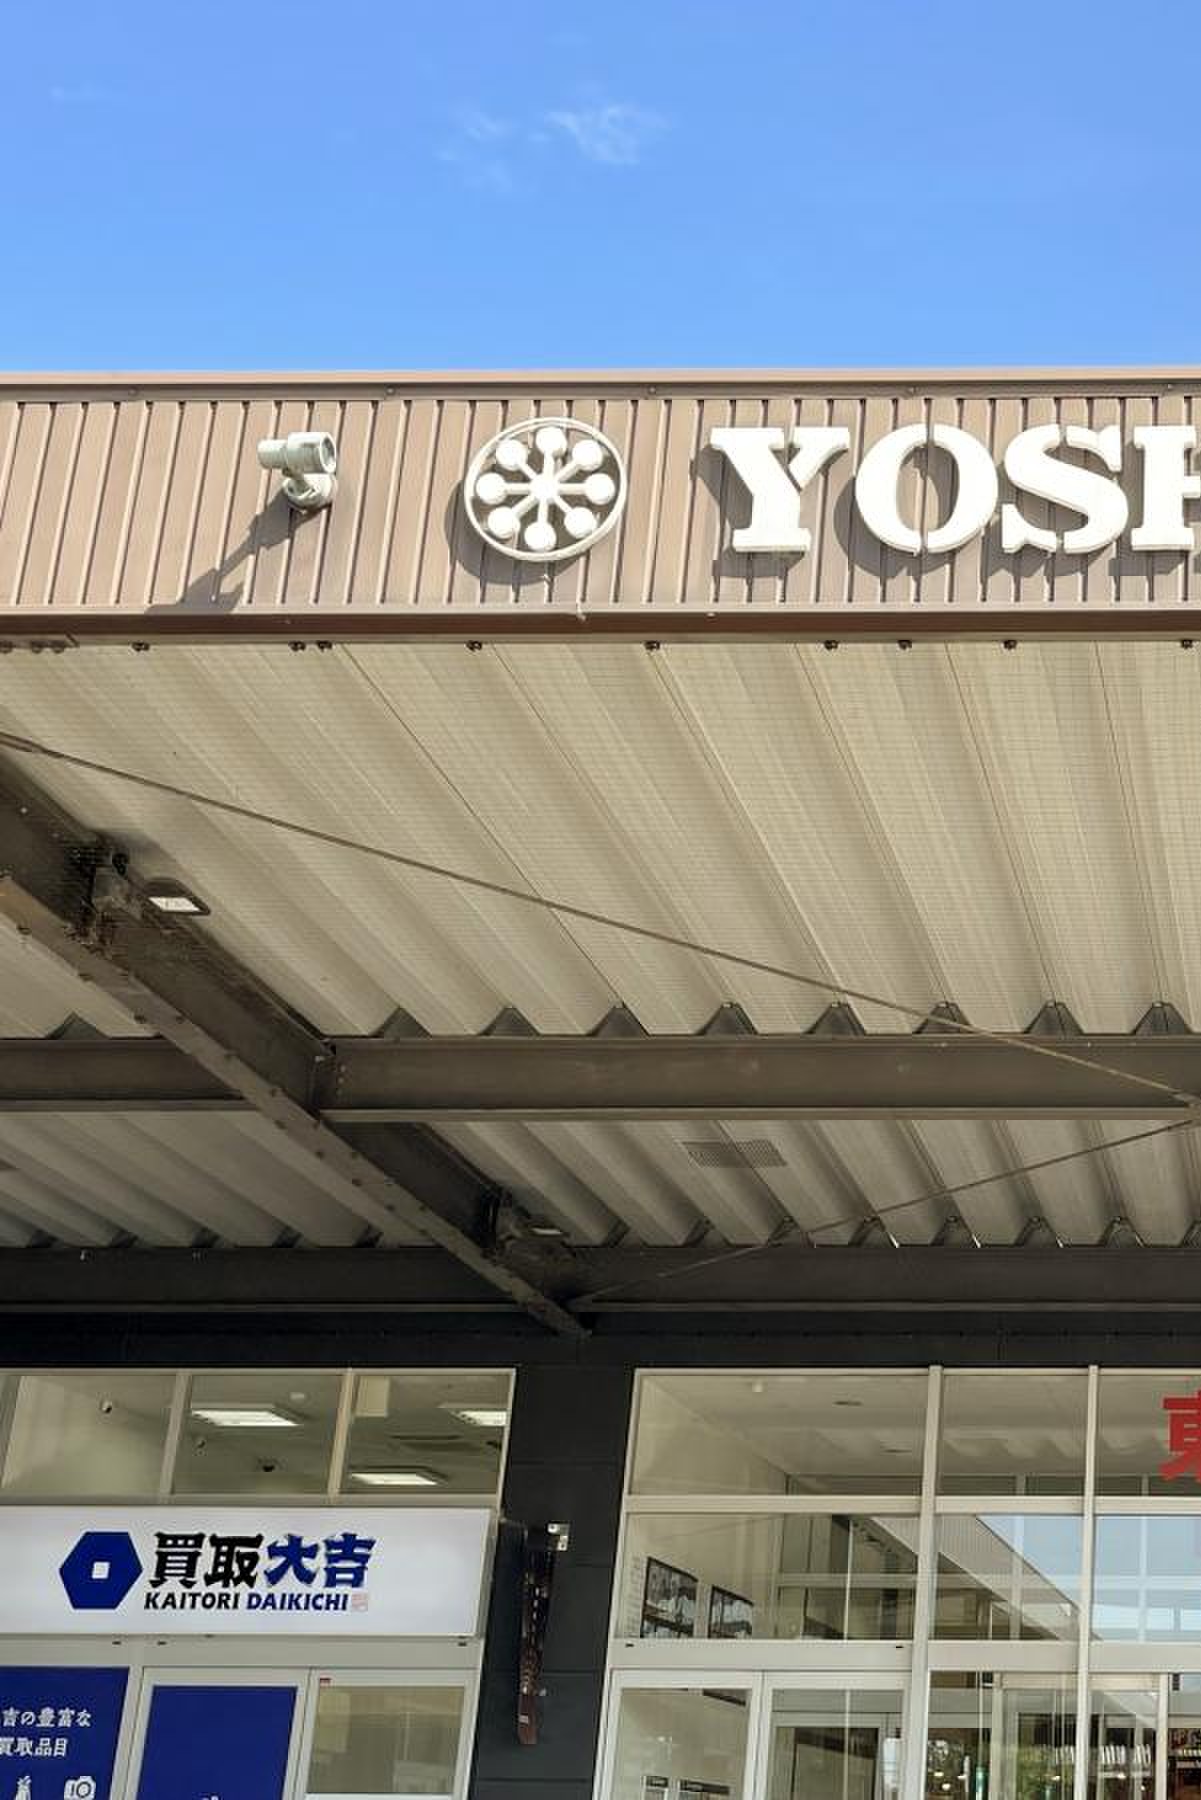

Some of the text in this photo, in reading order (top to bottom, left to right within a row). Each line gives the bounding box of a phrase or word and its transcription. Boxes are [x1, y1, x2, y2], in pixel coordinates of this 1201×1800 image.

[150, 1532, 376, 1588] 買取大吉
[144, 1592, 240, 1610] KAITORI
[246, 1593, 349, 1611] DAIKICHI
[2, 1707, 92, 1728] 吉の豊富な
[0, 1737, 68, 1757] 買取品目
